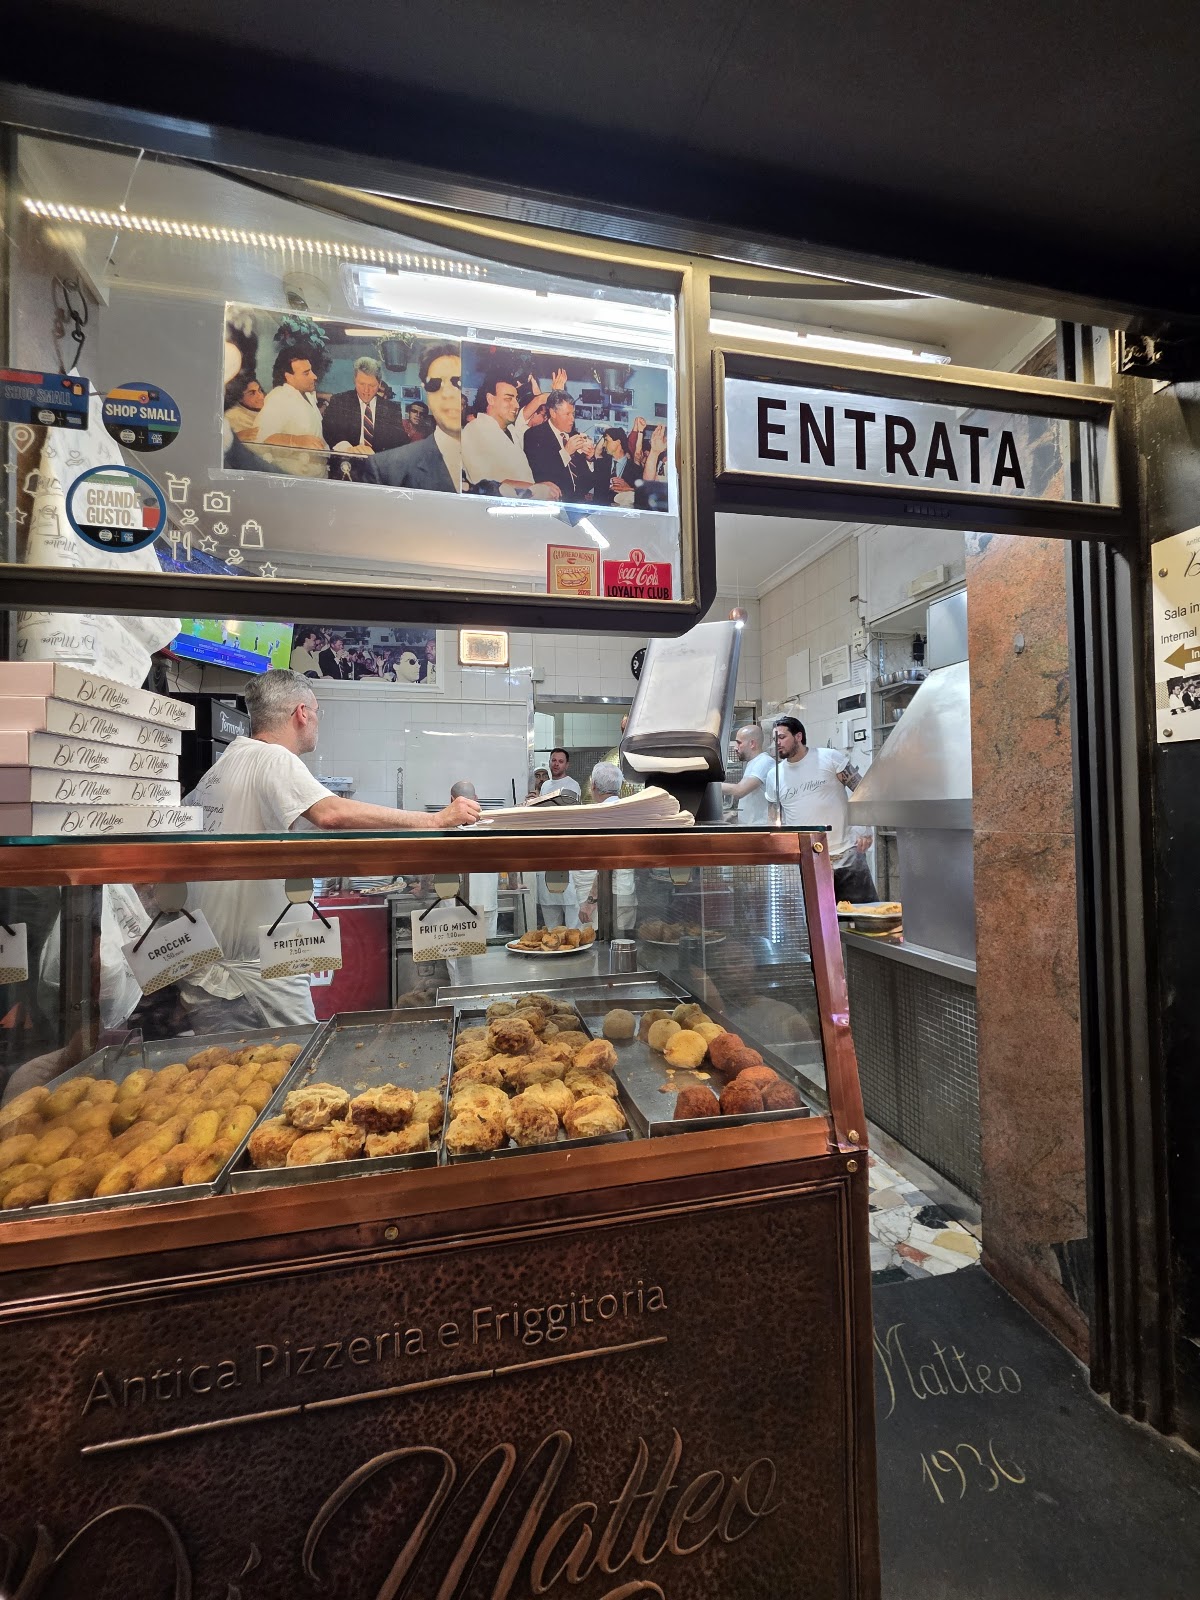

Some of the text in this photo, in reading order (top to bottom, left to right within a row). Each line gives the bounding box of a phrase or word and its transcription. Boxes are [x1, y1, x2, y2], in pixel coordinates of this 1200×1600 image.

[5, 385, 72, 406] SHOP SMALL
[105, 403, 177, 421] SHOP SMALL
[757, 396, 1025, 490] ENTRATA
[86, 488, 141, 509] GRANDE
[86, 506, 135, 527] GUSTO.
[607, 585, 669, 599] LOYALTY CLUB
[1164, 606, 1187, 621] Sala
[1161, 627, 1197, 644] Internal
[77, 679, 129, 709] Di Matteo
[149, 698, 162, 716] Di
[69, 711, 119, 741] Di Matteo
[137, 725, 150, 744] Di
[54, 744, 109, 771] Di Matteo
[129, 753, 144, 771] Di
[55, 778, 111, 803] Di Matteo
[131, 782, 146, 800] Di
[61, 810, 123, 833] Di Matteo
[147, 810, 164, 828] Di
[419, 920, 477, 934] FRITTO MISTO
[148, 932, 191, 960] CROCCHÈ
[273, 935, 325, 949] FRITTATINA
[81, 1280, 668, 1416] Antica Pizzeria e Friggitoria
[873, 1322, 1022, 1420] Matteo
[920, 1438, 1026, 1504] 1936
[303, 1428, 782, 1600] Matteo
